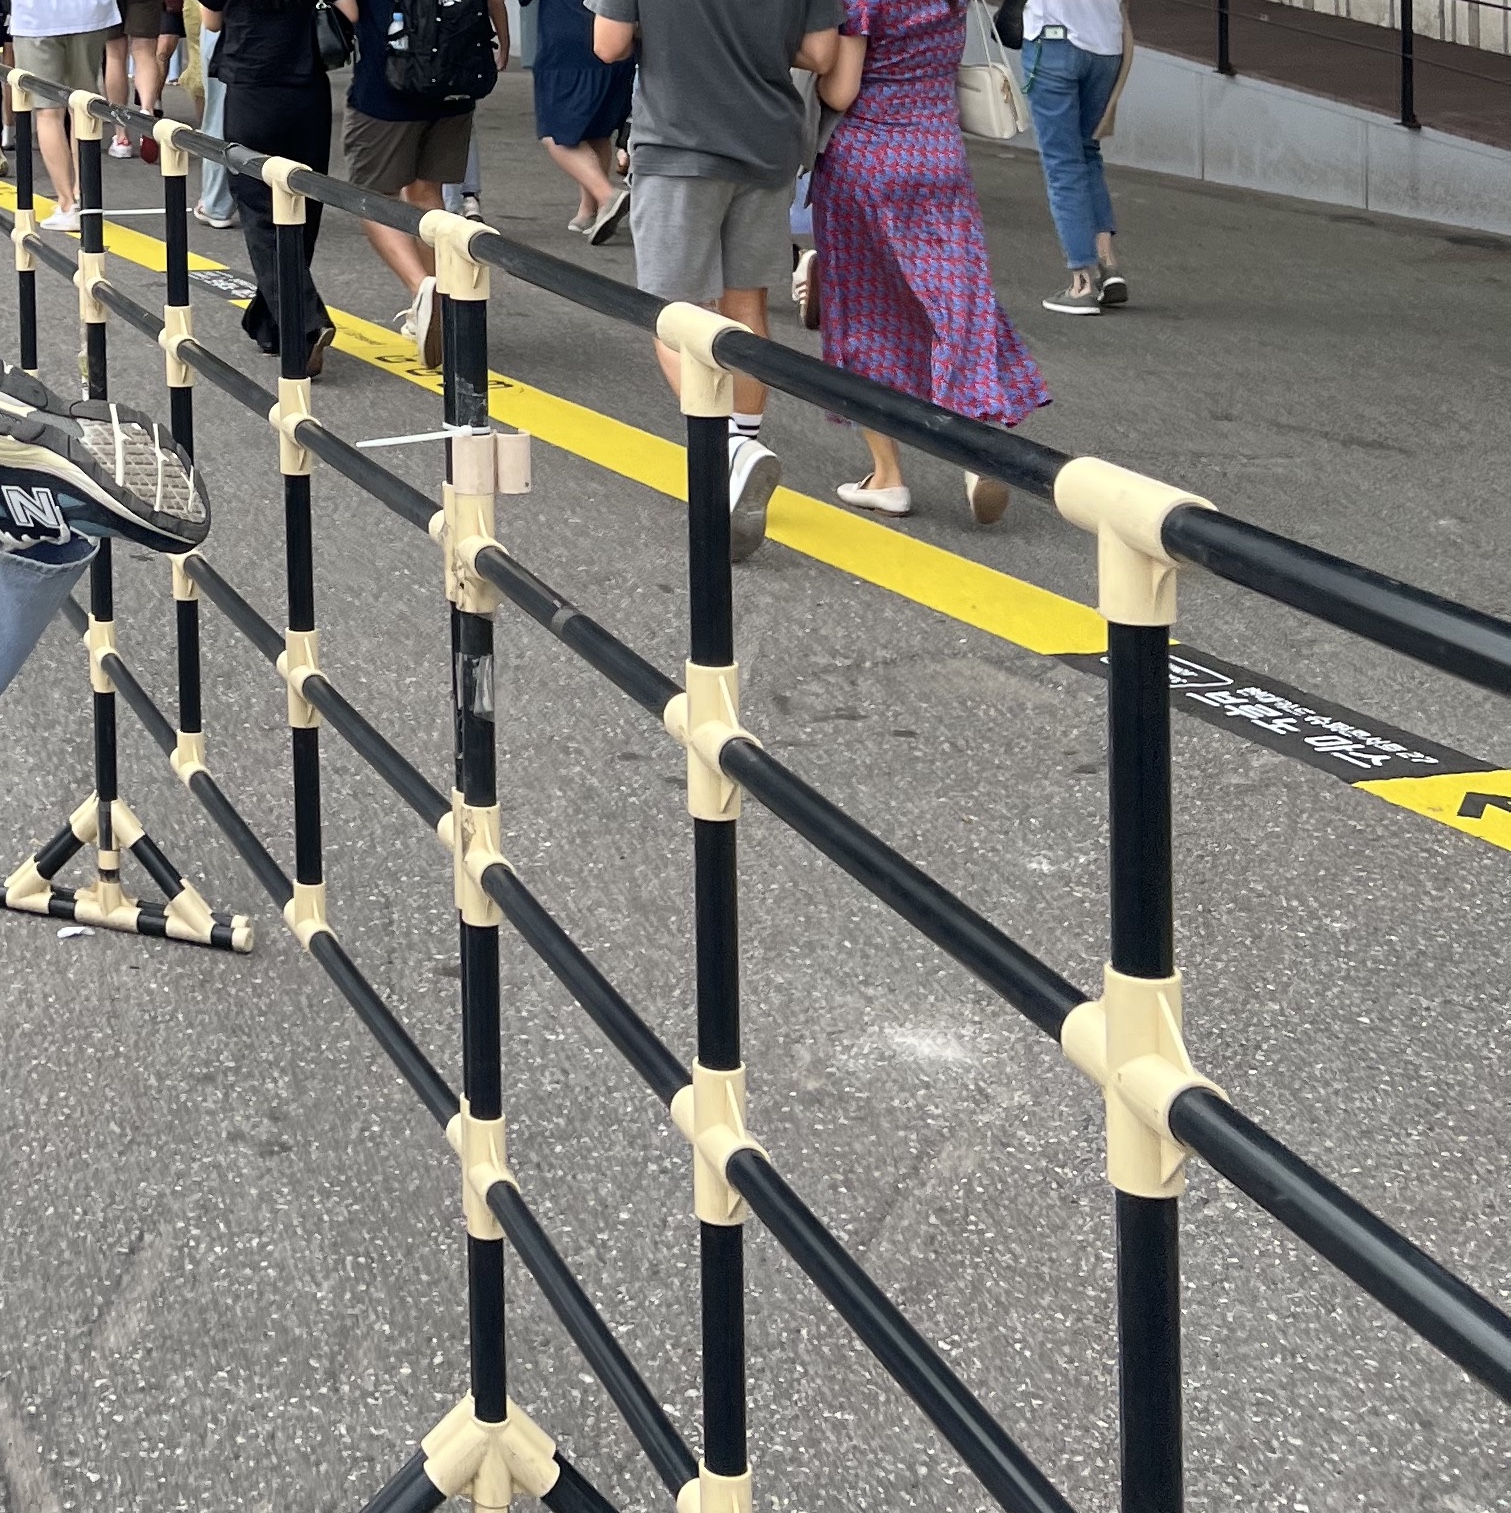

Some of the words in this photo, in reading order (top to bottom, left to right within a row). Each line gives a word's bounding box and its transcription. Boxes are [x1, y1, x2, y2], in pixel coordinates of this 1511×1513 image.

[1, 485, 62, 529] N
[1185, 690, 1301, 735] 브루노
[1304, 735, 1392, 769] 마스
